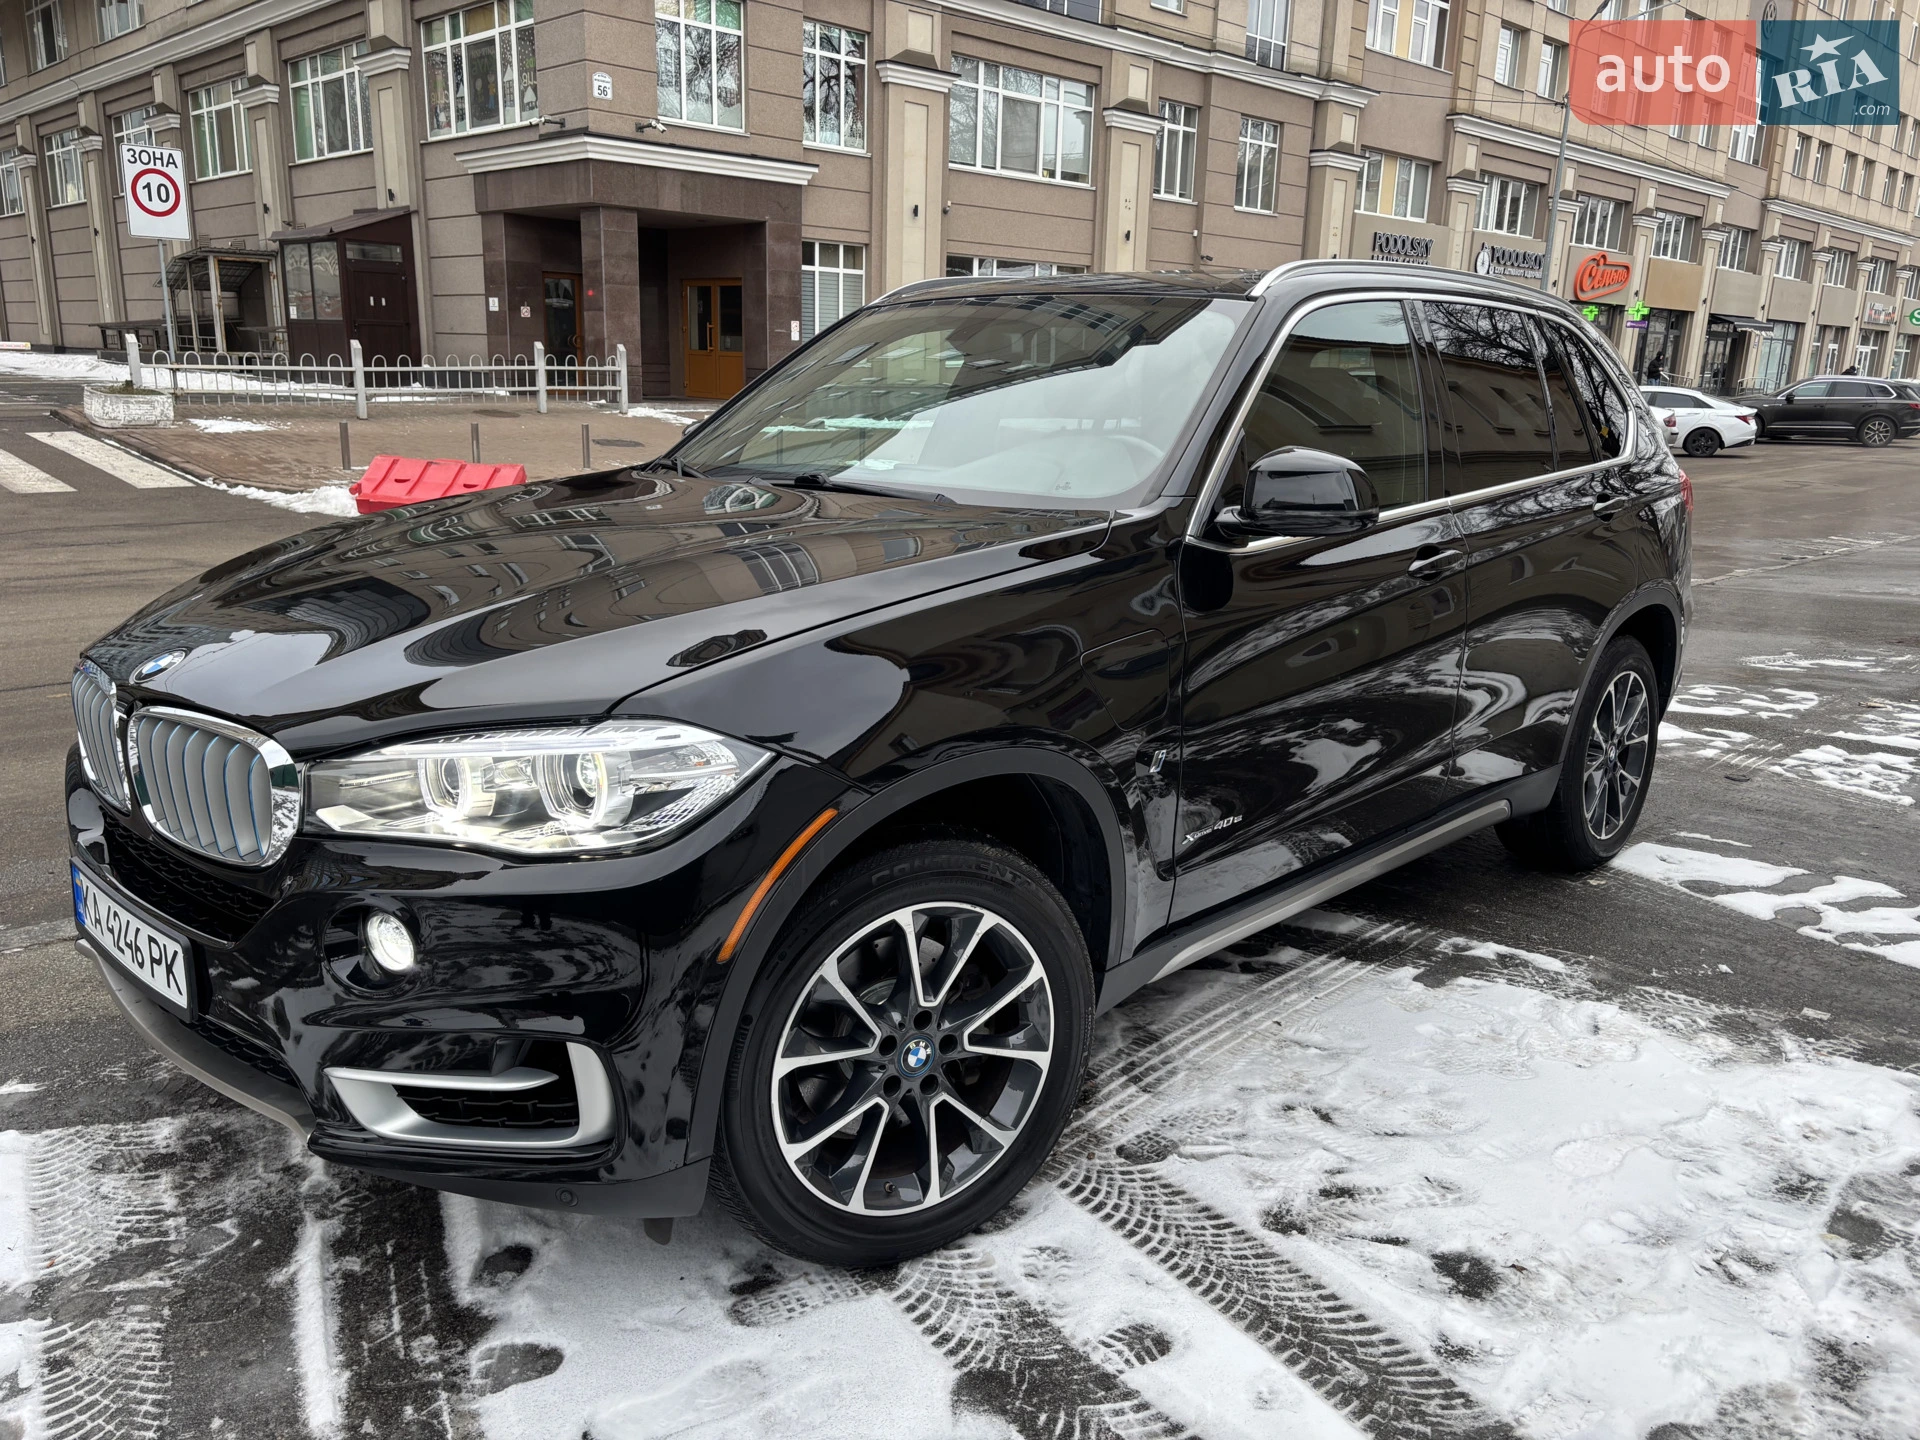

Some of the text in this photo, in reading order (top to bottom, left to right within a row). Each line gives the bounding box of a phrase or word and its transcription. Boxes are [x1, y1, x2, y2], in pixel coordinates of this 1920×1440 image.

[126, 148, 178, 169] ЗОНА
[142, 181, 170, 203] 10
[1372, 231, 1434, 257] PODOLSKY
[1582, 257, 1628, 292] Сільпо
[106, 905, 145, 969] 4246
[909, 1041, 932, 1055] BMW
